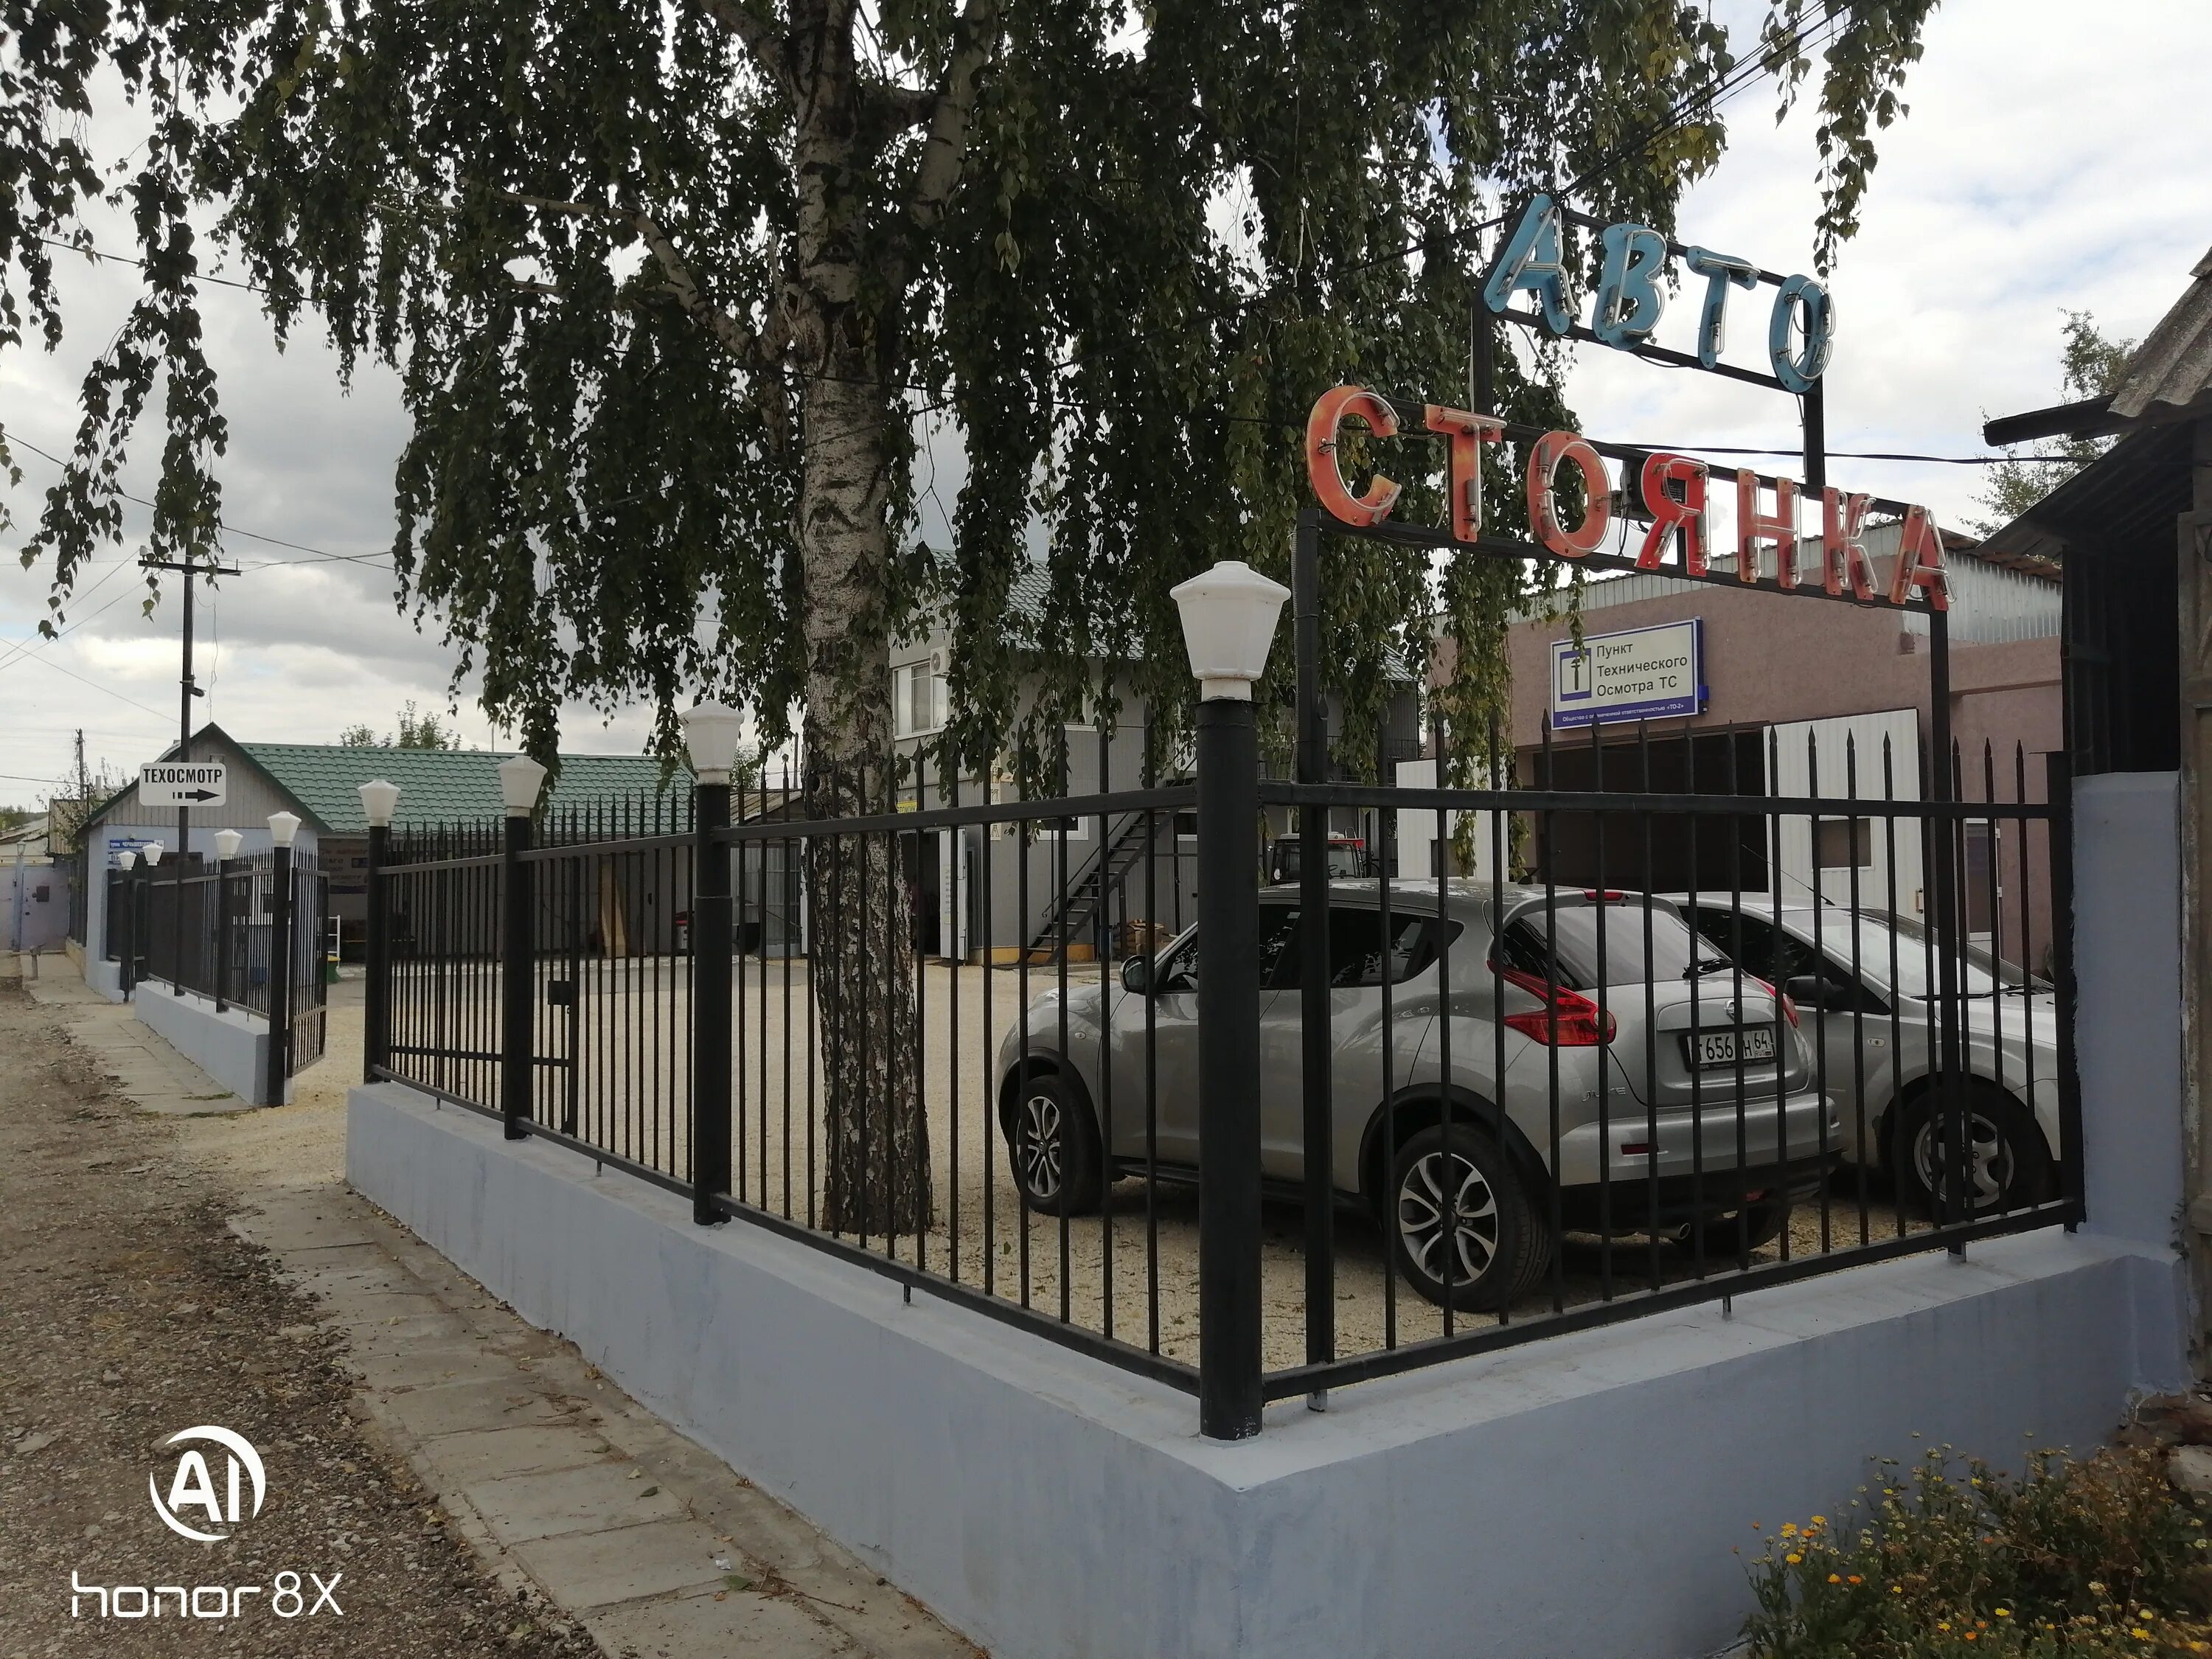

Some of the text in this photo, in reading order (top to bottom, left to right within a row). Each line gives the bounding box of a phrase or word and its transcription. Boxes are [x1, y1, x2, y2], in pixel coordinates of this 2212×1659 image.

[1484, 193, 1837, 394] АВТО
[1307, 386, 1958, 612] СТОЯНКА
[1596, 643, 1634, 659] Пункт
[1596, 655, 1688, 677] Технического
[1596, 675, 1677, 697] Осмотра ТС
[143, 768, 223, 783] ТЕХОСМОТР
[1754, 1032, 1768, 1049] 64
